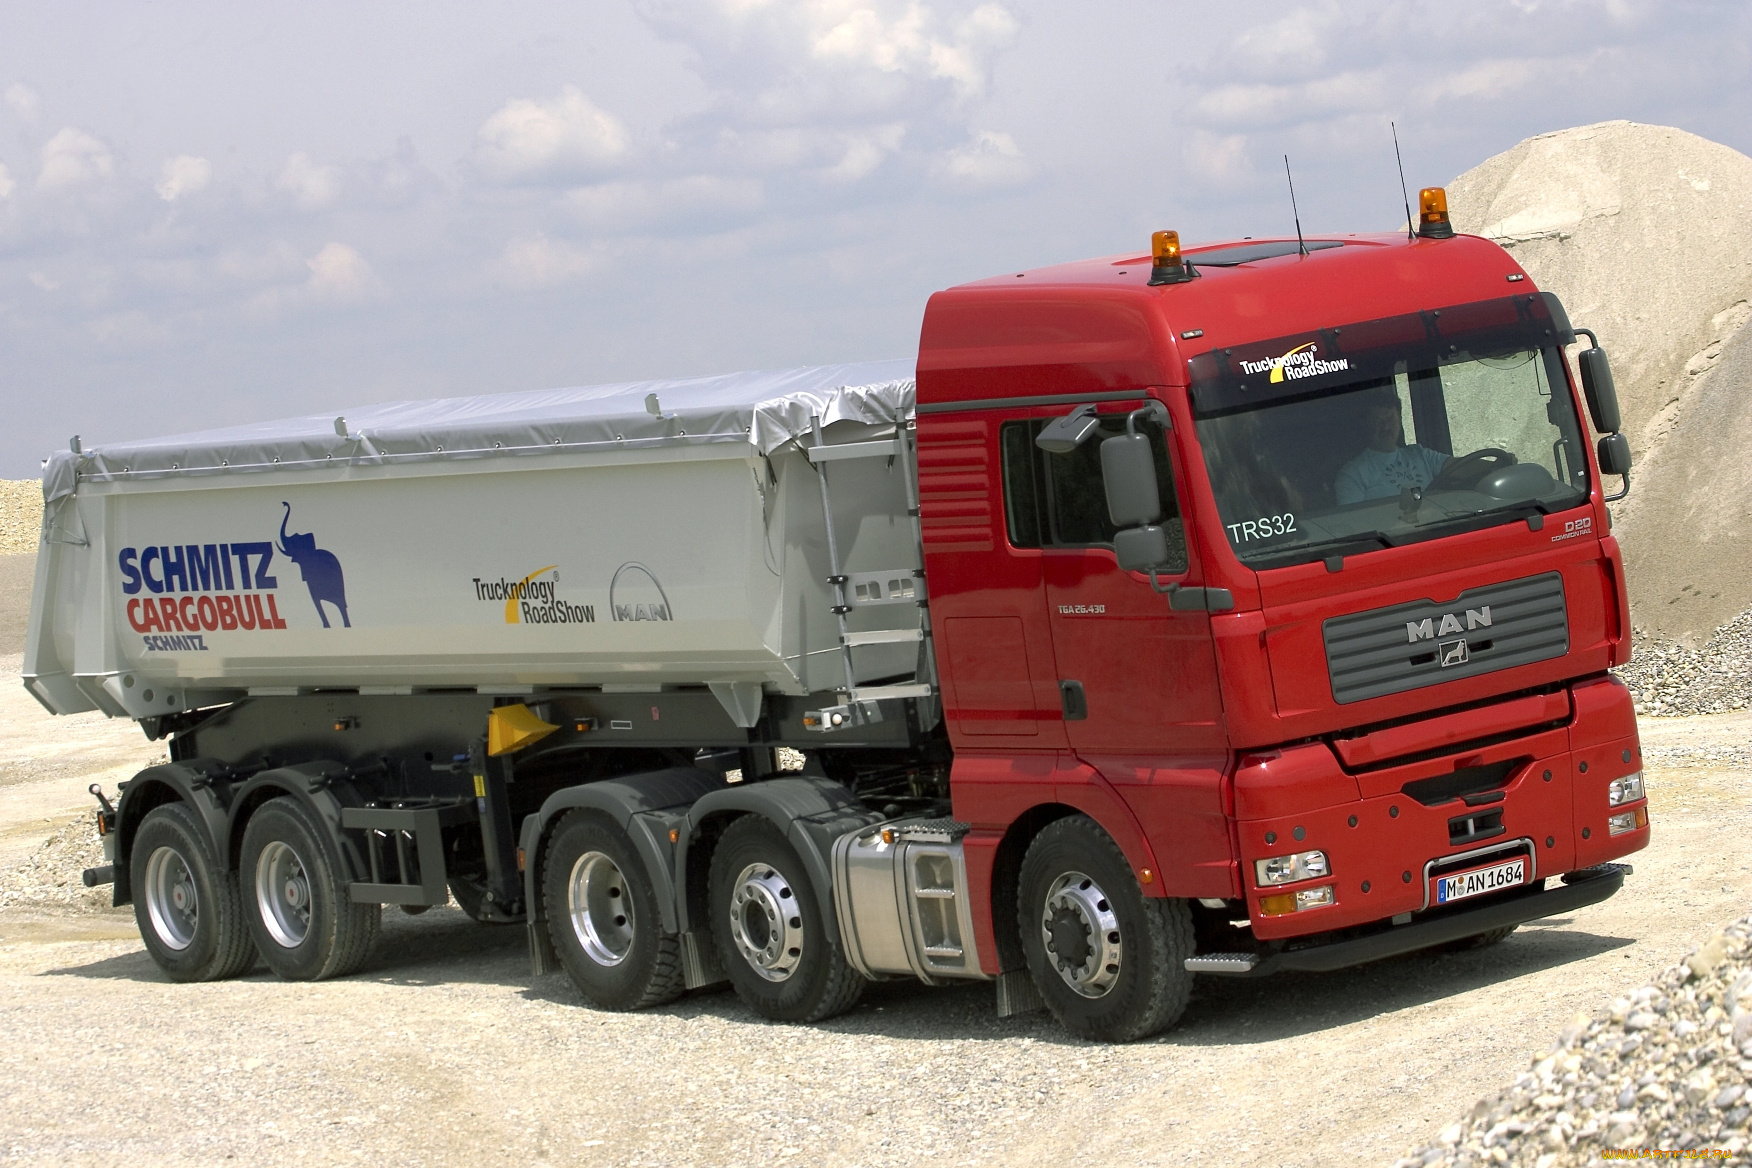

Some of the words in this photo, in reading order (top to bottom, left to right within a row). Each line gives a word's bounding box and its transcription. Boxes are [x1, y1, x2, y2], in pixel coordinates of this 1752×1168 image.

[1239, 350, 1316, 375] Trucknology
[1284, 358, 1349, 381] RoadShow
[1227, 513, 1297, 544] TRS32
[118, 541, 278, 595] SCHMITZ
[472, 576, 555, 605] Trucknology
[126, 593, 287, 633] CARGOBULL
[521, 600, 596, 624] RoadShow
[615, 603, 668, 622] MAN
[1058, 605, 1075, 614] TGA
[1075, 604, 1105, 614] 26.430
[1406, 605, 1492, 643] MAN
[143, 634, 209, 651] SCHMITZ
[1487, 864, 1523, 888] 1684
